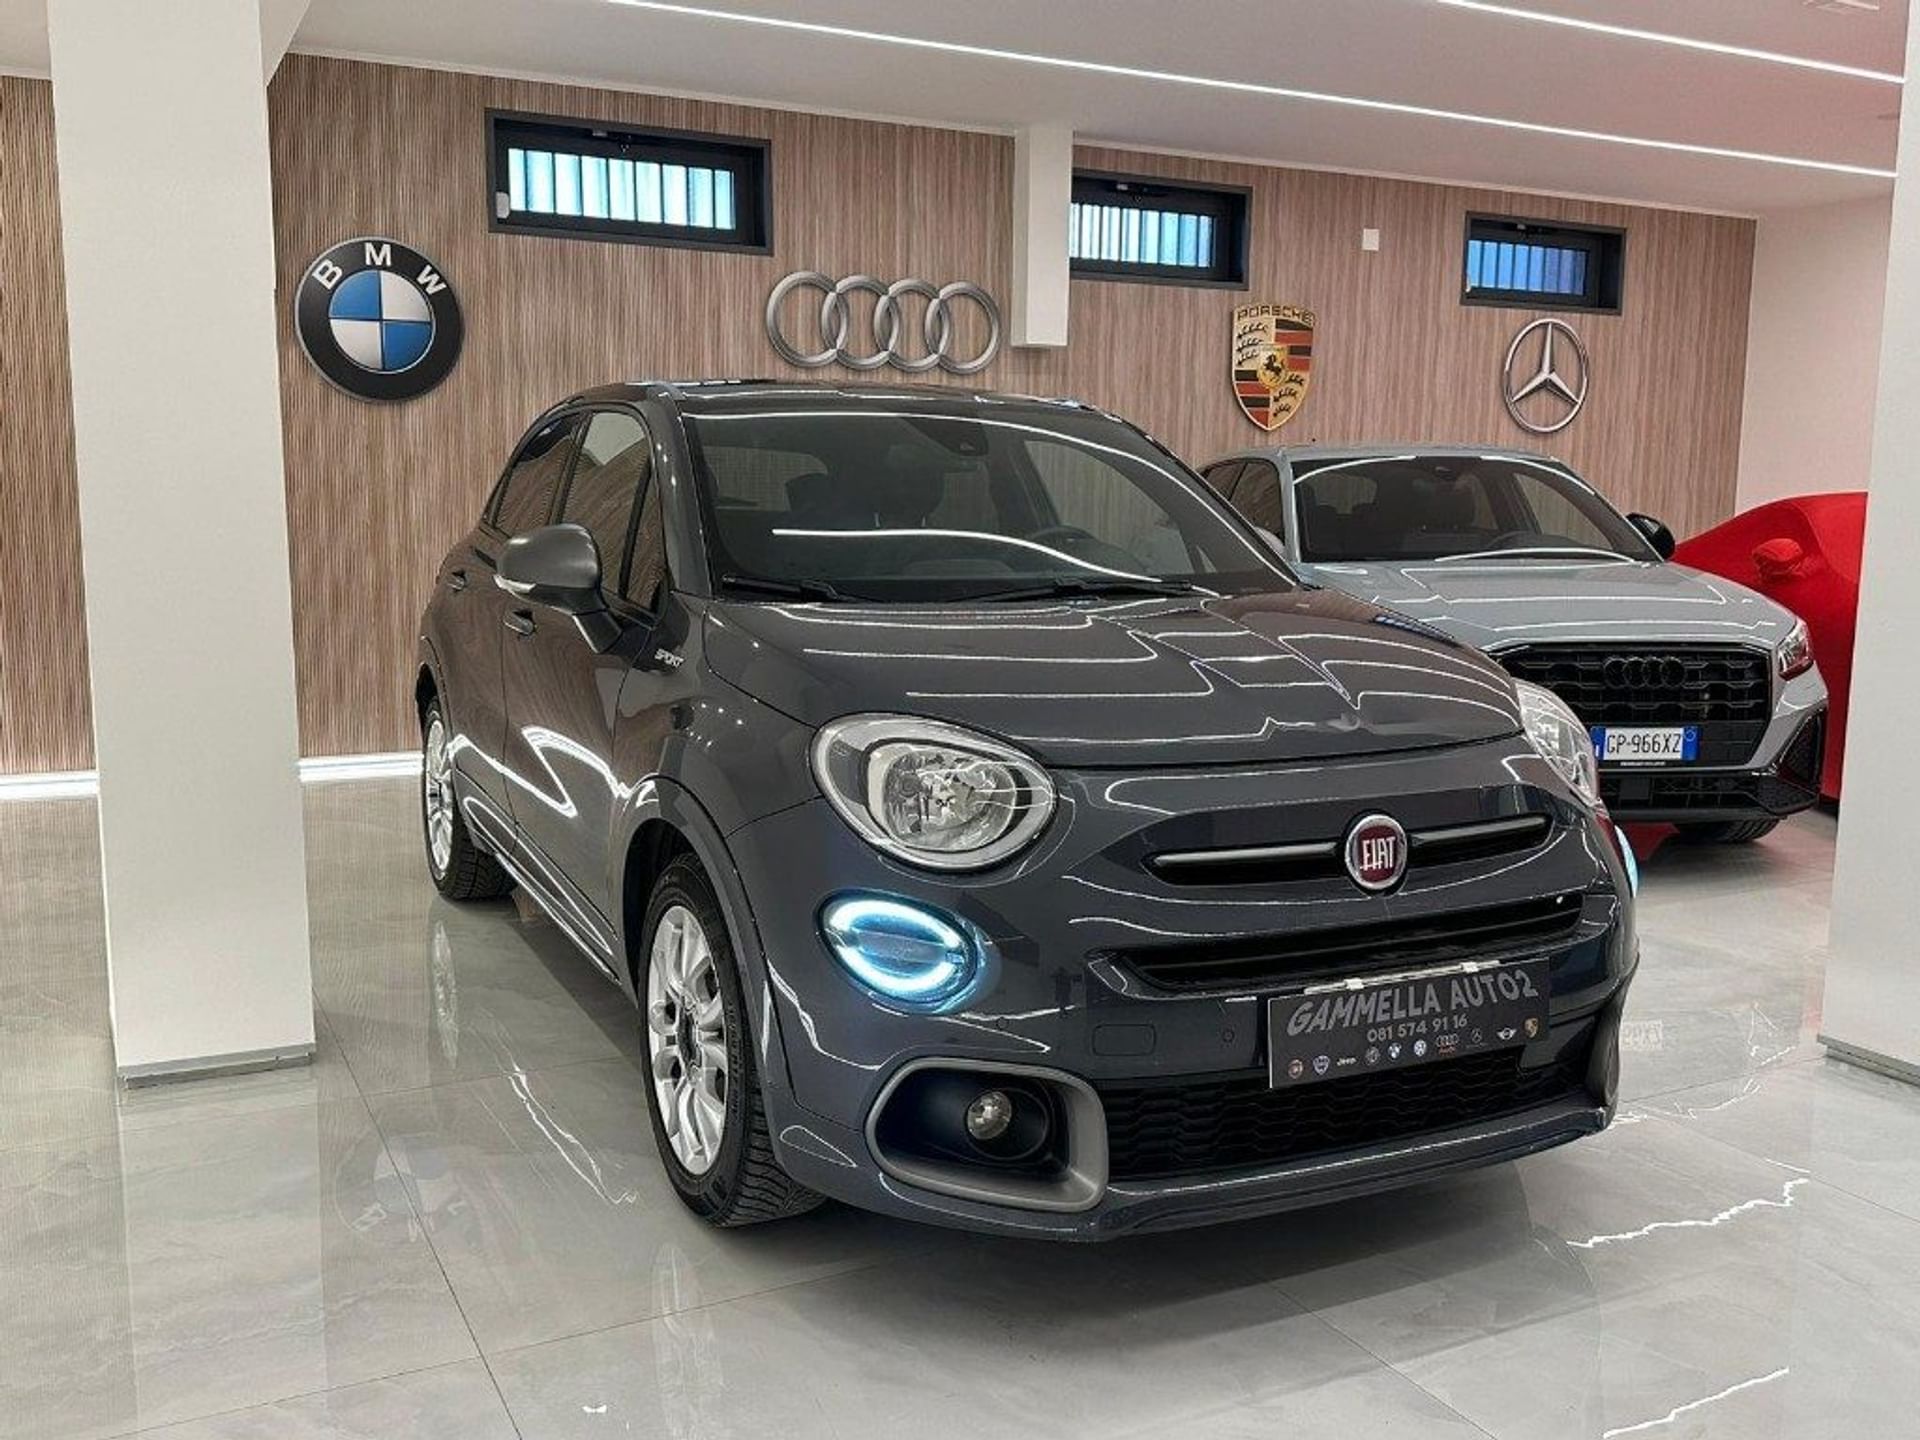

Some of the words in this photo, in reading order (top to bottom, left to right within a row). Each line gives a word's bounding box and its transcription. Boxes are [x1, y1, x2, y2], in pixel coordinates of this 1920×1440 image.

[312, 242, 446, 295] BMW
[1236, 304, 1316, 325] PORSCHE
[1360, 836, 1396, 871] FIAT
[1286, 983, 1442, 1036] GAMMELLA
[1450, 969, 1539, 1011] AUTO2
[1367, 1025, 1394, 1042] 081
[1399, 1019, 1428, 1038] 574
[1432, 1015, 1449, 1033] 91
[1452, 1013, 1468, 1030] 16
